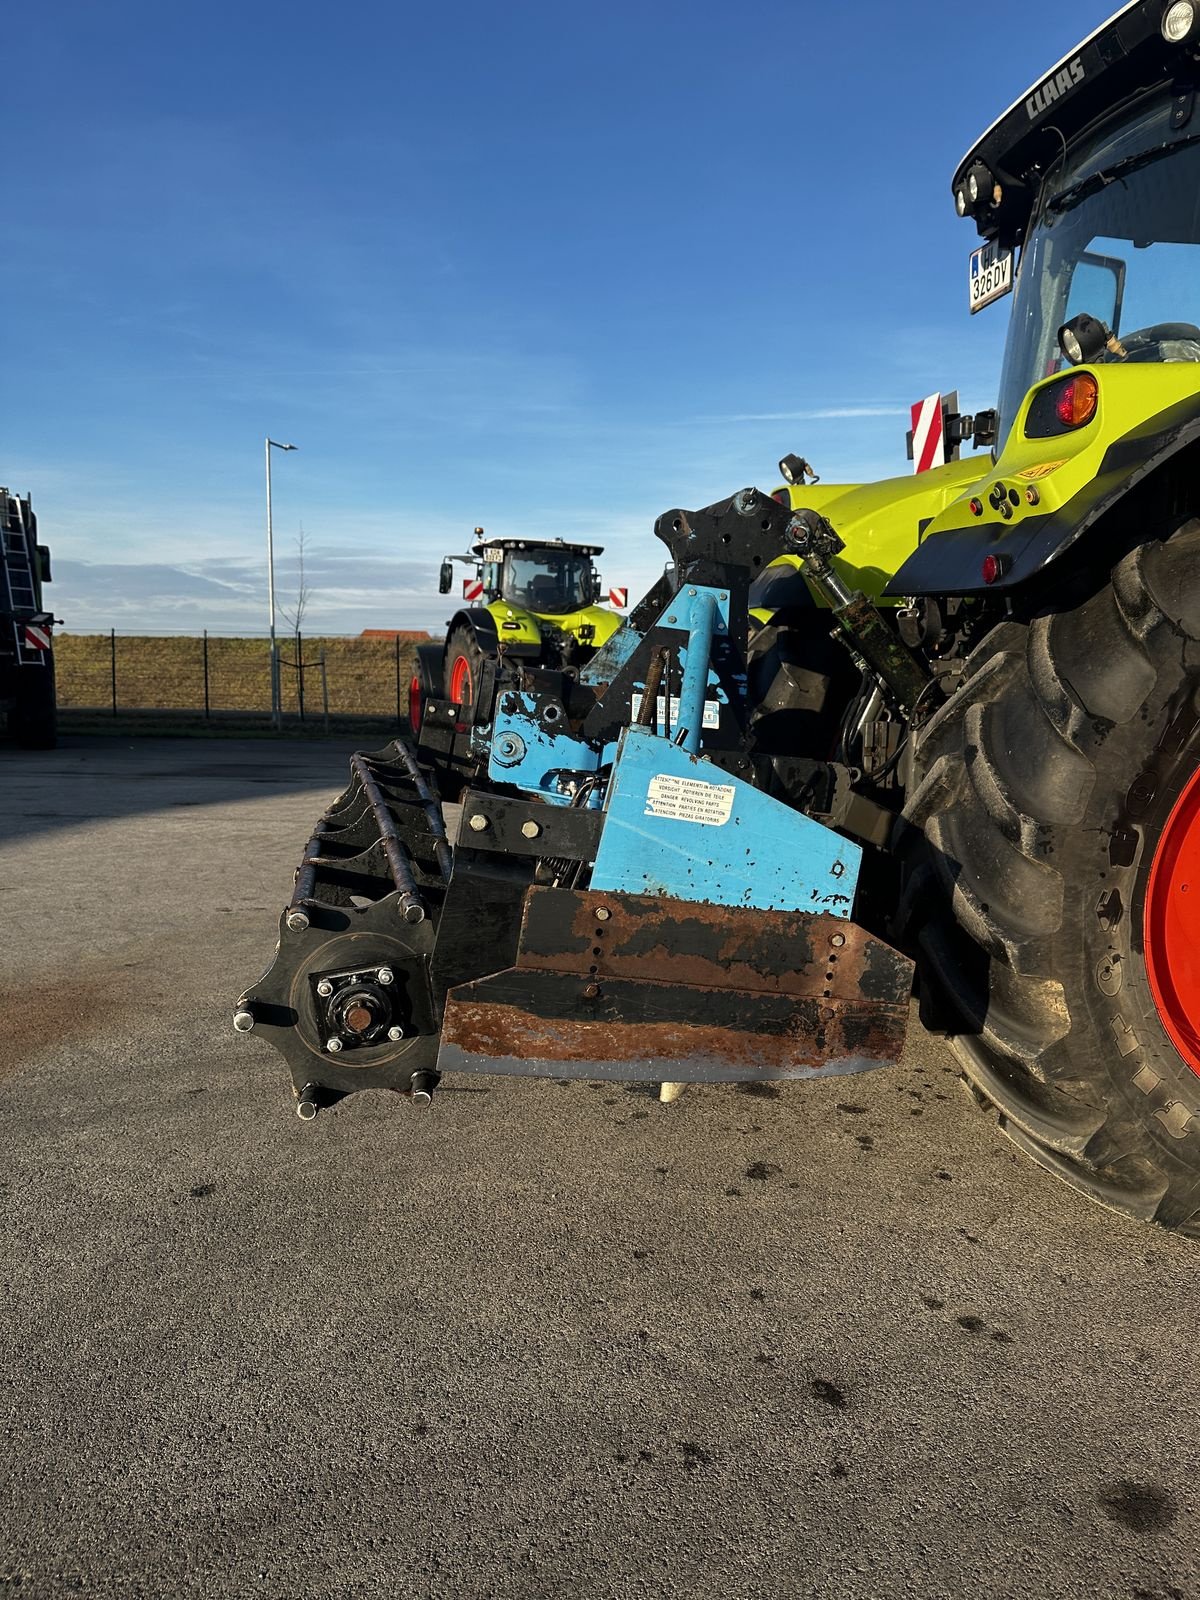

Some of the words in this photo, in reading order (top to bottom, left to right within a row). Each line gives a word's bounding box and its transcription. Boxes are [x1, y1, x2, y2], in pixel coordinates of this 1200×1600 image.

[1025, 56, 1085, 120] CLAAS
[973, 271, 992, 300] 326
[994, 260, 1008, 288] DV
[682, 780, 703, 788] ELEMENTI
[681, 797, 705, 805] REVOLVING
